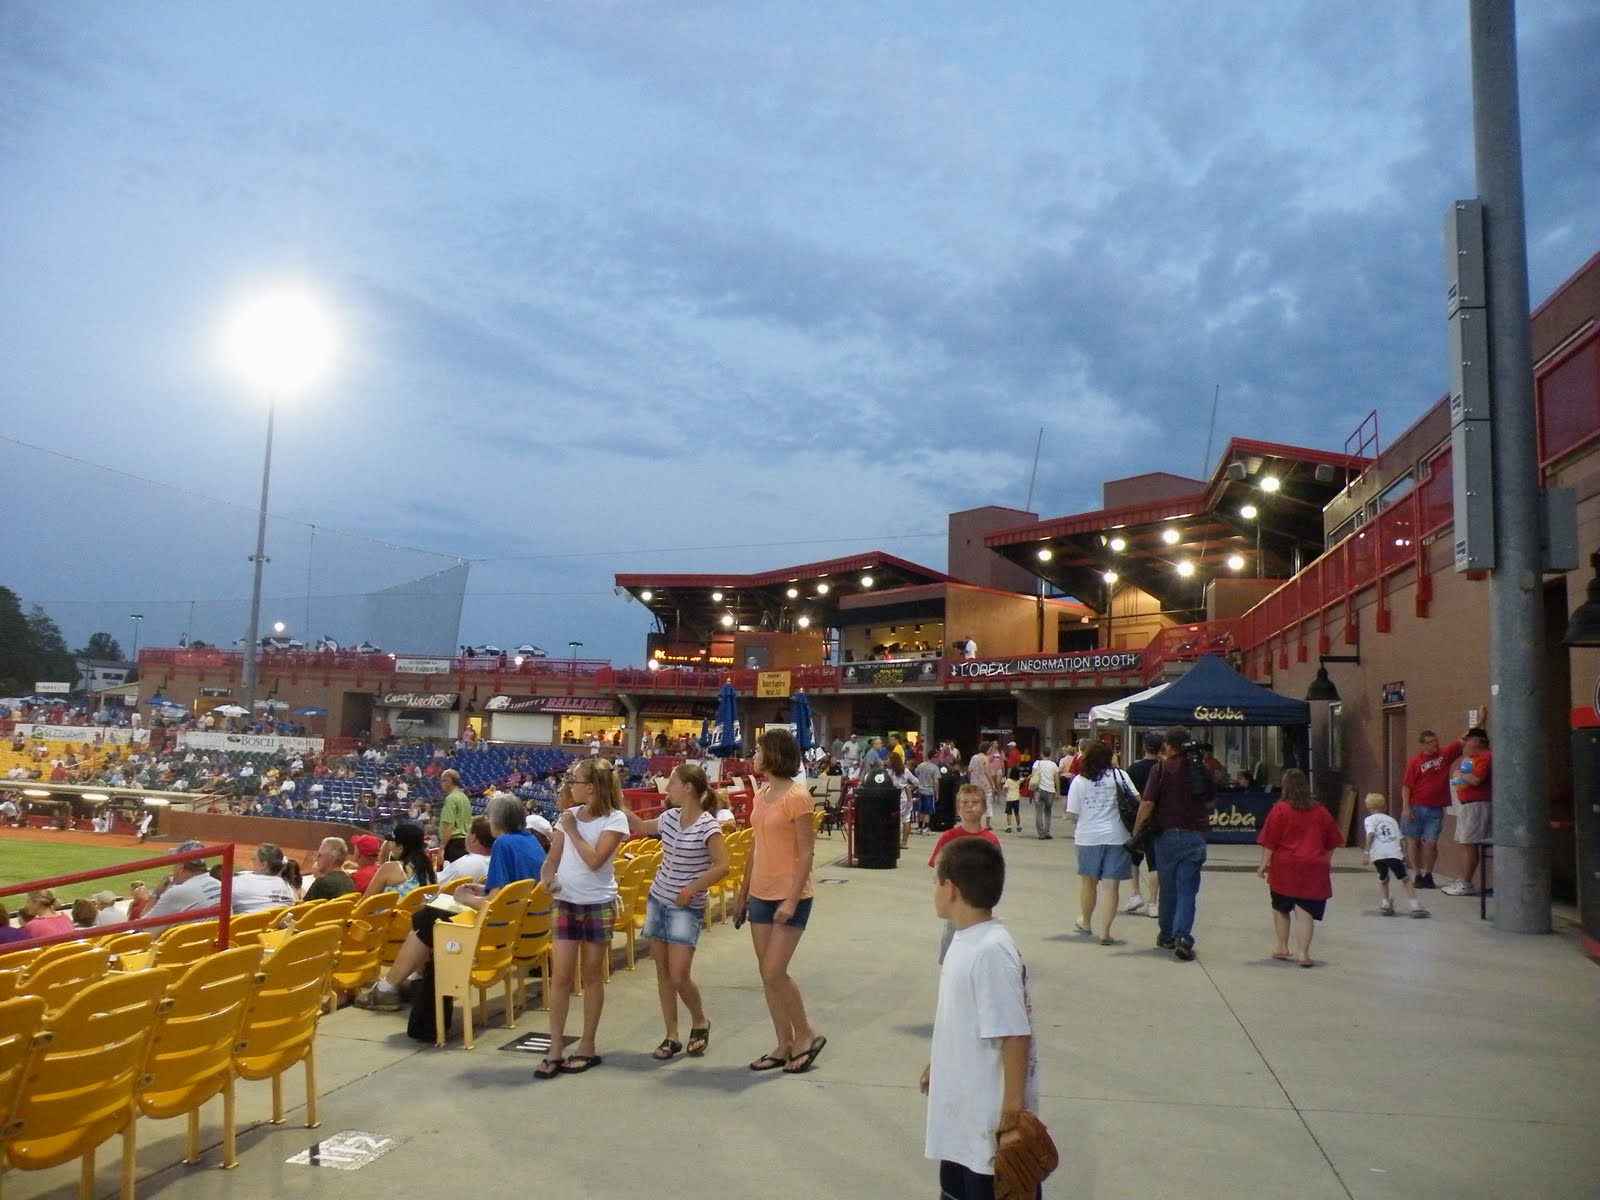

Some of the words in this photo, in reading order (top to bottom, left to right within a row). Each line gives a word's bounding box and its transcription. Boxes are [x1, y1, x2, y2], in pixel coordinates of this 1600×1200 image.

[1018, 657, 1090, 671] INFORMATION
[1095, 654, 1135, 667] BOOTH
[407, 694, 445, 707] Nacho
[1194, 705, 1246, 721] Qdoba
[242, 736, 274, 747] BOSCH
[1208, 805, 1257, 826] doba
